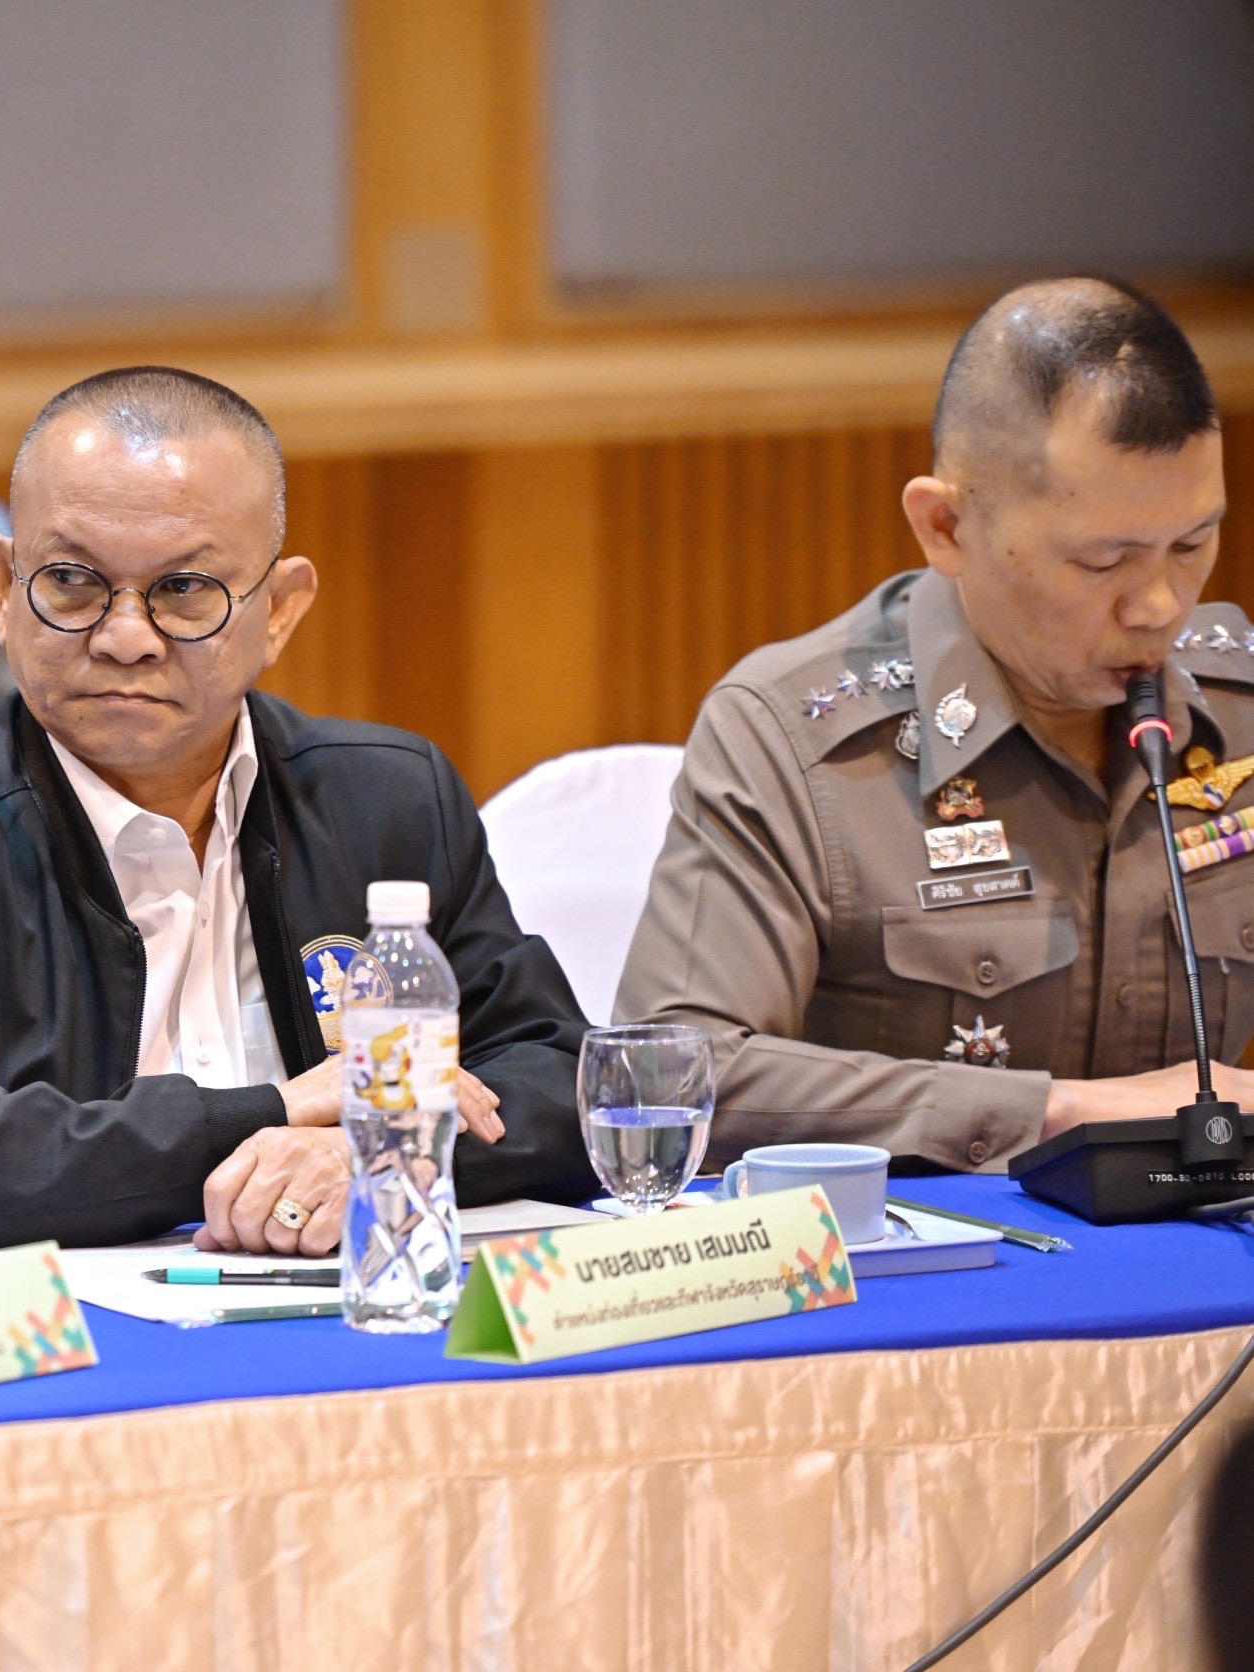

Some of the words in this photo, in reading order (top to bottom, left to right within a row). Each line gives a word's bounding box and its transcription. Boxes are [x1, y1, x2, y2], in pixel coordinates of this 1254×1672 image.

[575, 1241, 691, 1283] นายสมชาย
[695, 1218, 771, 1261] เสมมณี
